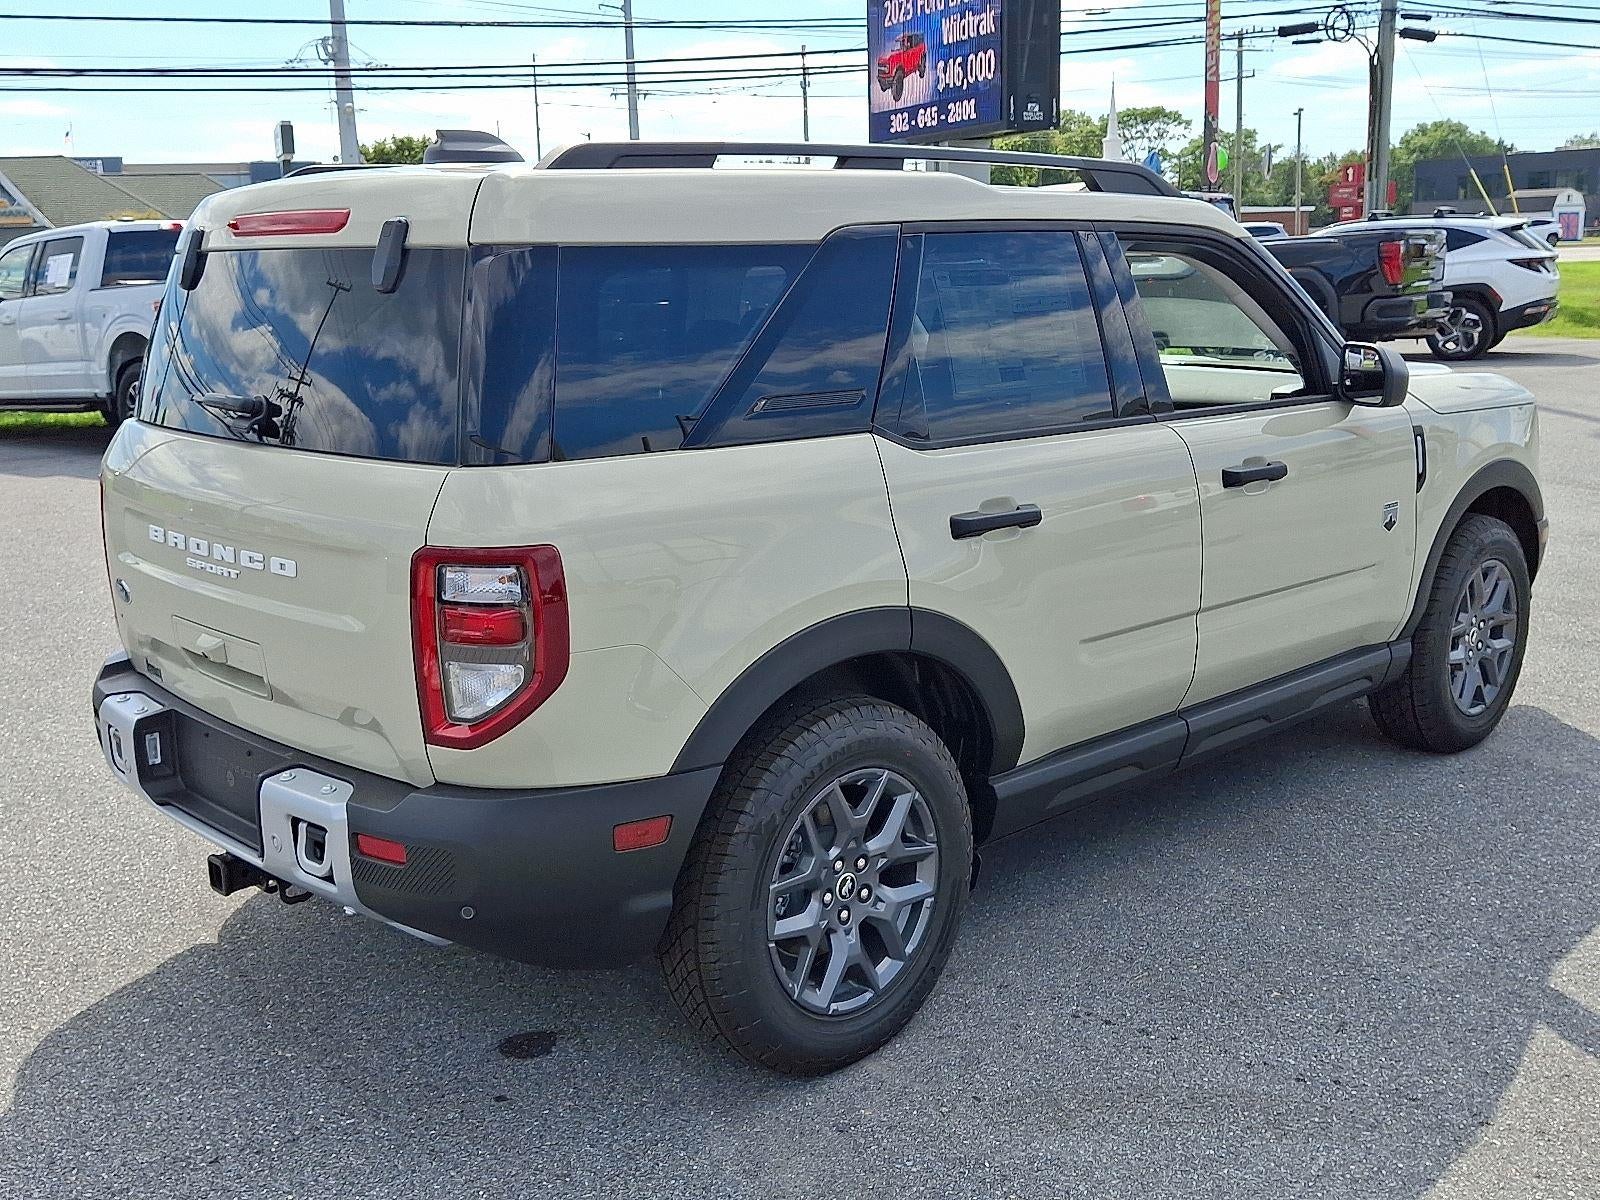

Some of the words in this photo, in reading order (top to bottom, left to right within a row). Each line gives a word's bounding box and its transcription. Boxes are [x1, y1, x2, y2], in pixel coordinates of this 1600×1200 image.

[884, 0, 913, 28] 2023
[942, 4, 995, 45] Wildtrak
[937, 49, 995, 92] $46,000
[149, 524, 297, 578] BRONCO
[185, 557, 241, 579] SPORT
